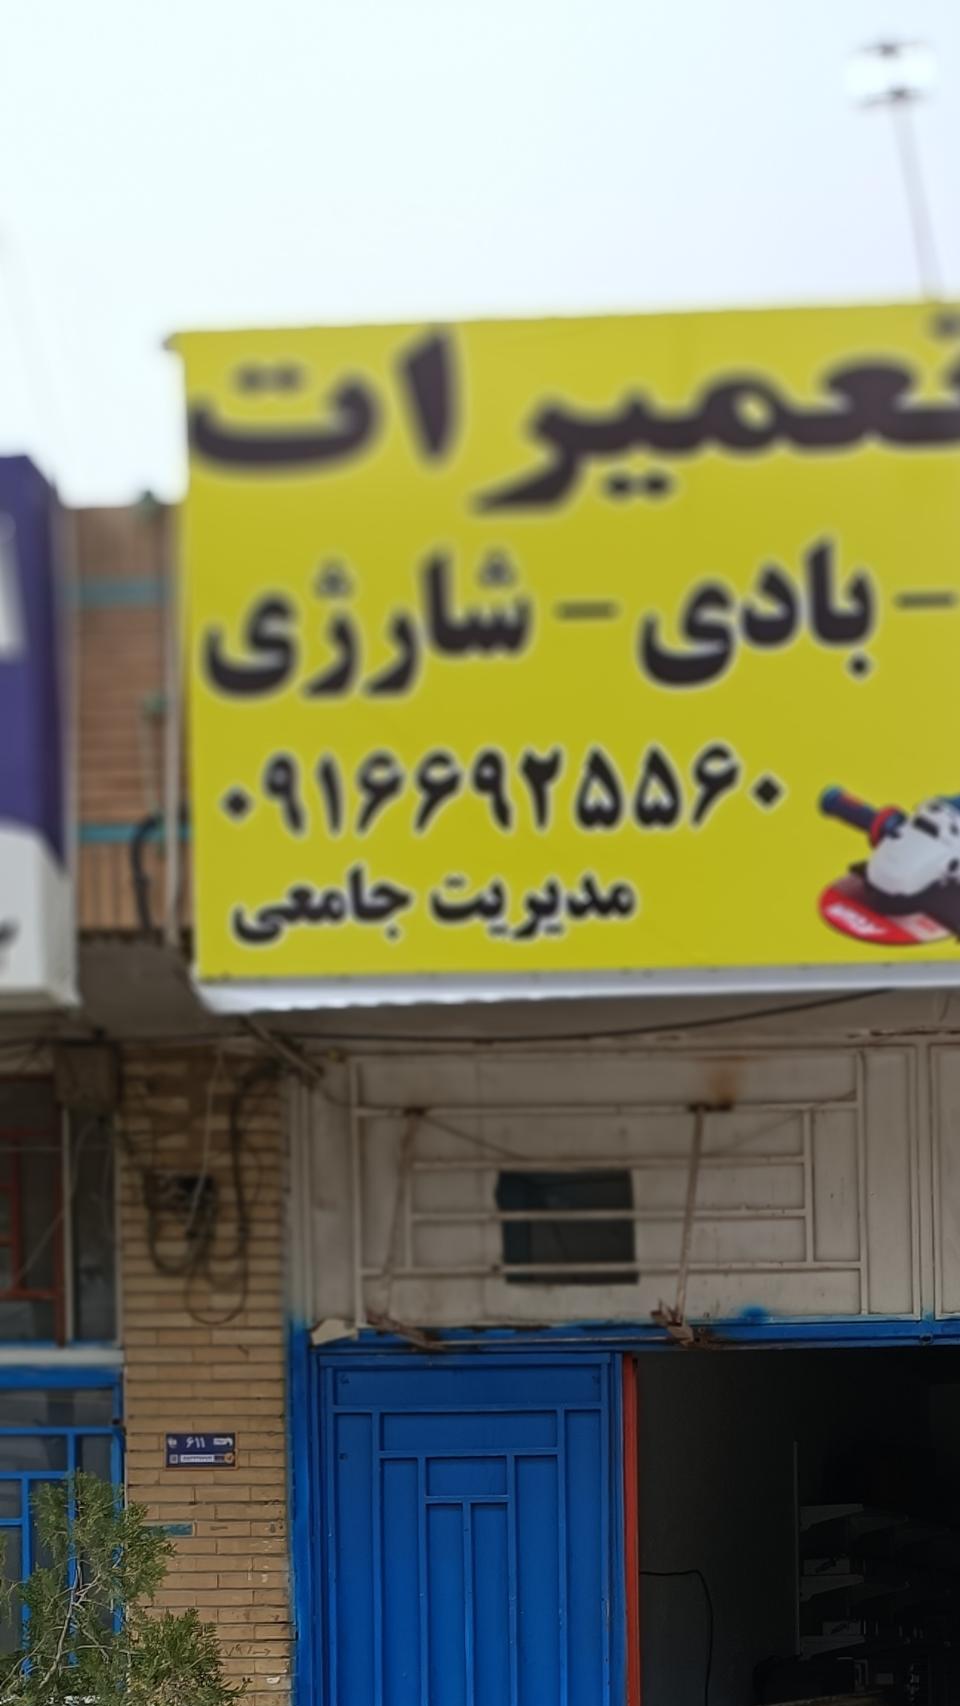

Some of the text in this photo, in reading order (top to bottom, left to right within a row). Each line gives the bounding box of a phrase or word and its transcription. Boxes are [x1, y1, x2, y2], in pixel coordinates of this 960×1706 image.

[202, 549, 533, 699] شارژی
[638, 536, 876, 688] بادی
[219, 742, 783, 836] ۰۹۱۶۶۹۲۵۵۶۰
[231, 867, 637, 944] مدیریت جامعی
